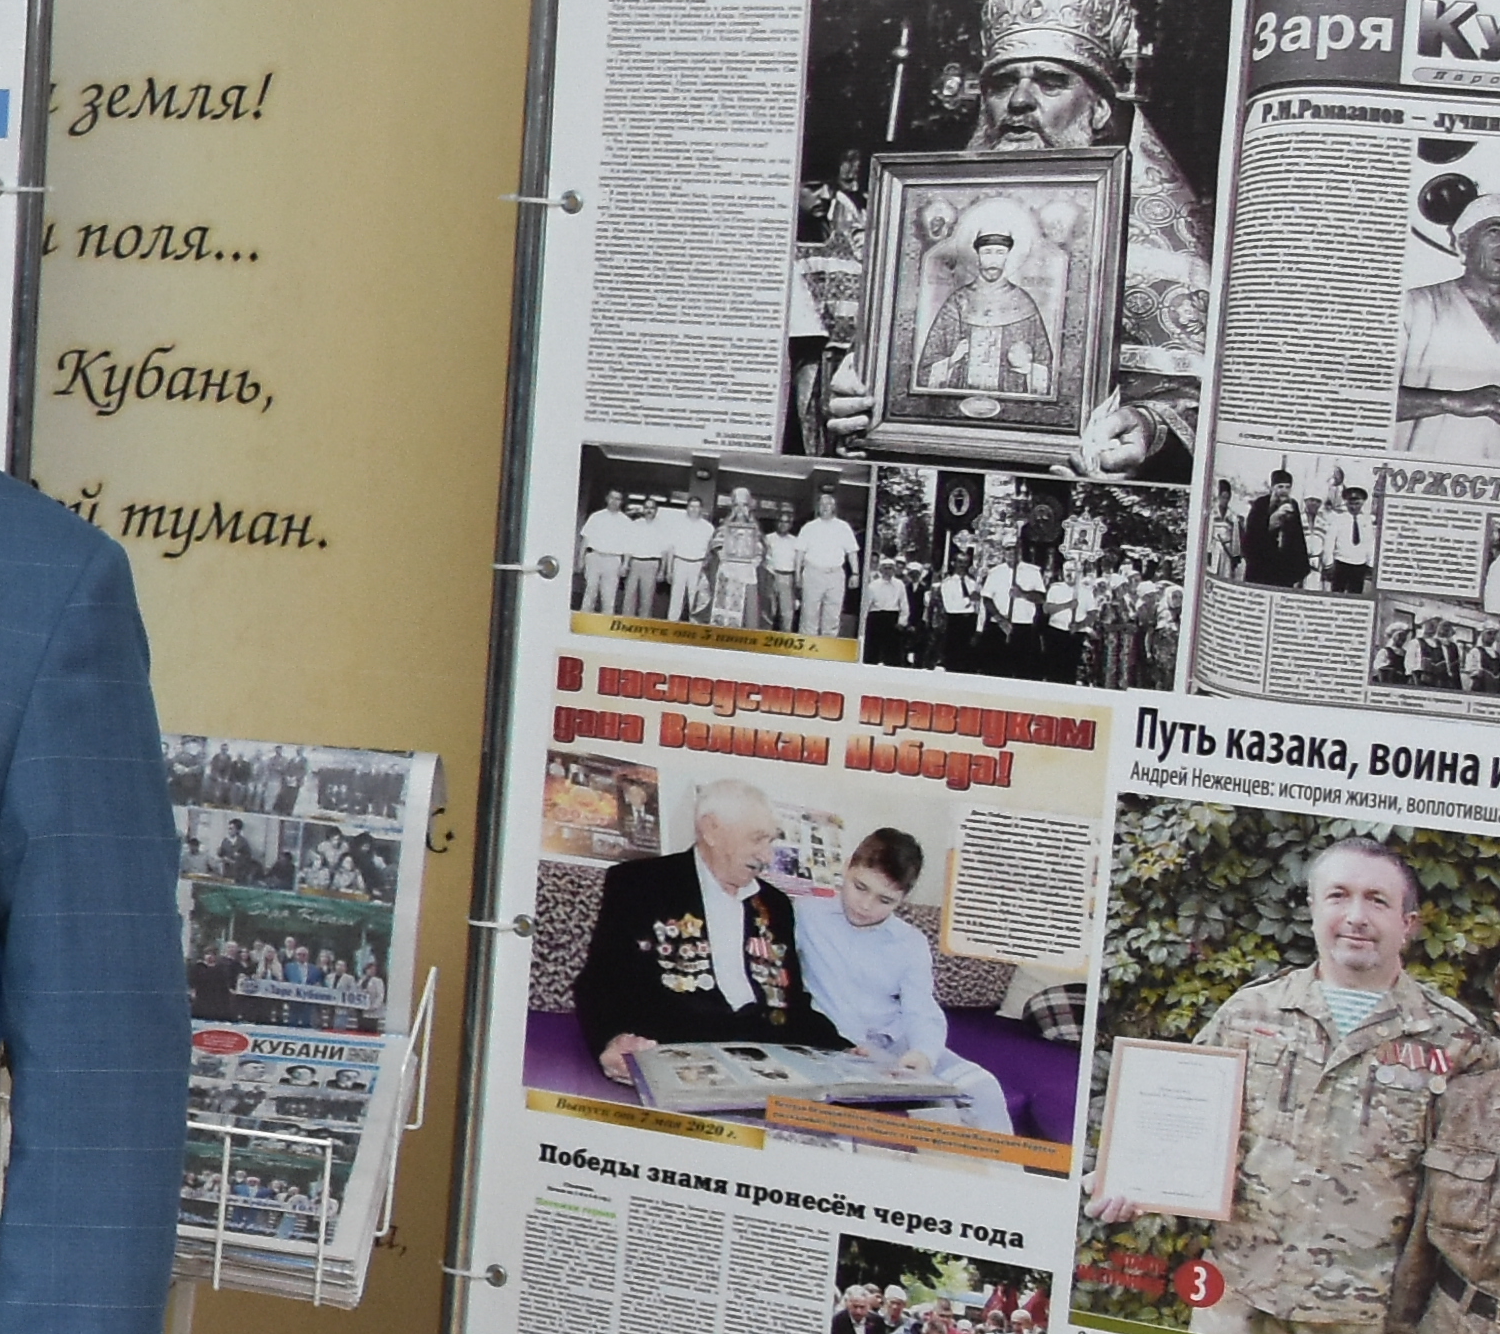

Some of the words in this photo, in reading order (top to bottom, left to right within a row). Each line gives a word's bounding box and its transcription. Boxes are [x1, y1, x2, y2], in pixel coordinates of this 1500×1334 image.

[1252, 11, 1394, 62] Заря
[68, 72, 274, 137] земля!
[75, 220, 261, 264] поля...
[53, 344, 275, 417] Кубань,
[120, 500, 330, 560] туман.
[556, 655, 584, 692] В
[597, 666, 845, 722] наследство
[859, 694, 1096, 751] правнукам
[552, 705, 645, 744] дана
[658, 712, 830, 766] Великая
[844, 735, 1014, 790] Победа!
[1135, 706, 1217, 763] Путь
[1225, 726, 1360, 781] казака,
[1368, 742, 1481, 787] воина
[1130, 760, 1189, 788] Андрей
[1192, 768, 1276, 798] Неженцев:
[1278, 782, 1342, 806] история
[1345, 791, 1403, 814] жизни,
[250, 1038, 346, 1064] КУБАНИ
[538, 1143, 640, 1179] Победы
[646, 1167, 728, 1195] знамя
[734, 1182, 866, 1220] пронесём
[873, 1207, 953, 1235] через
[959, 1222, 1024, 1249] года
